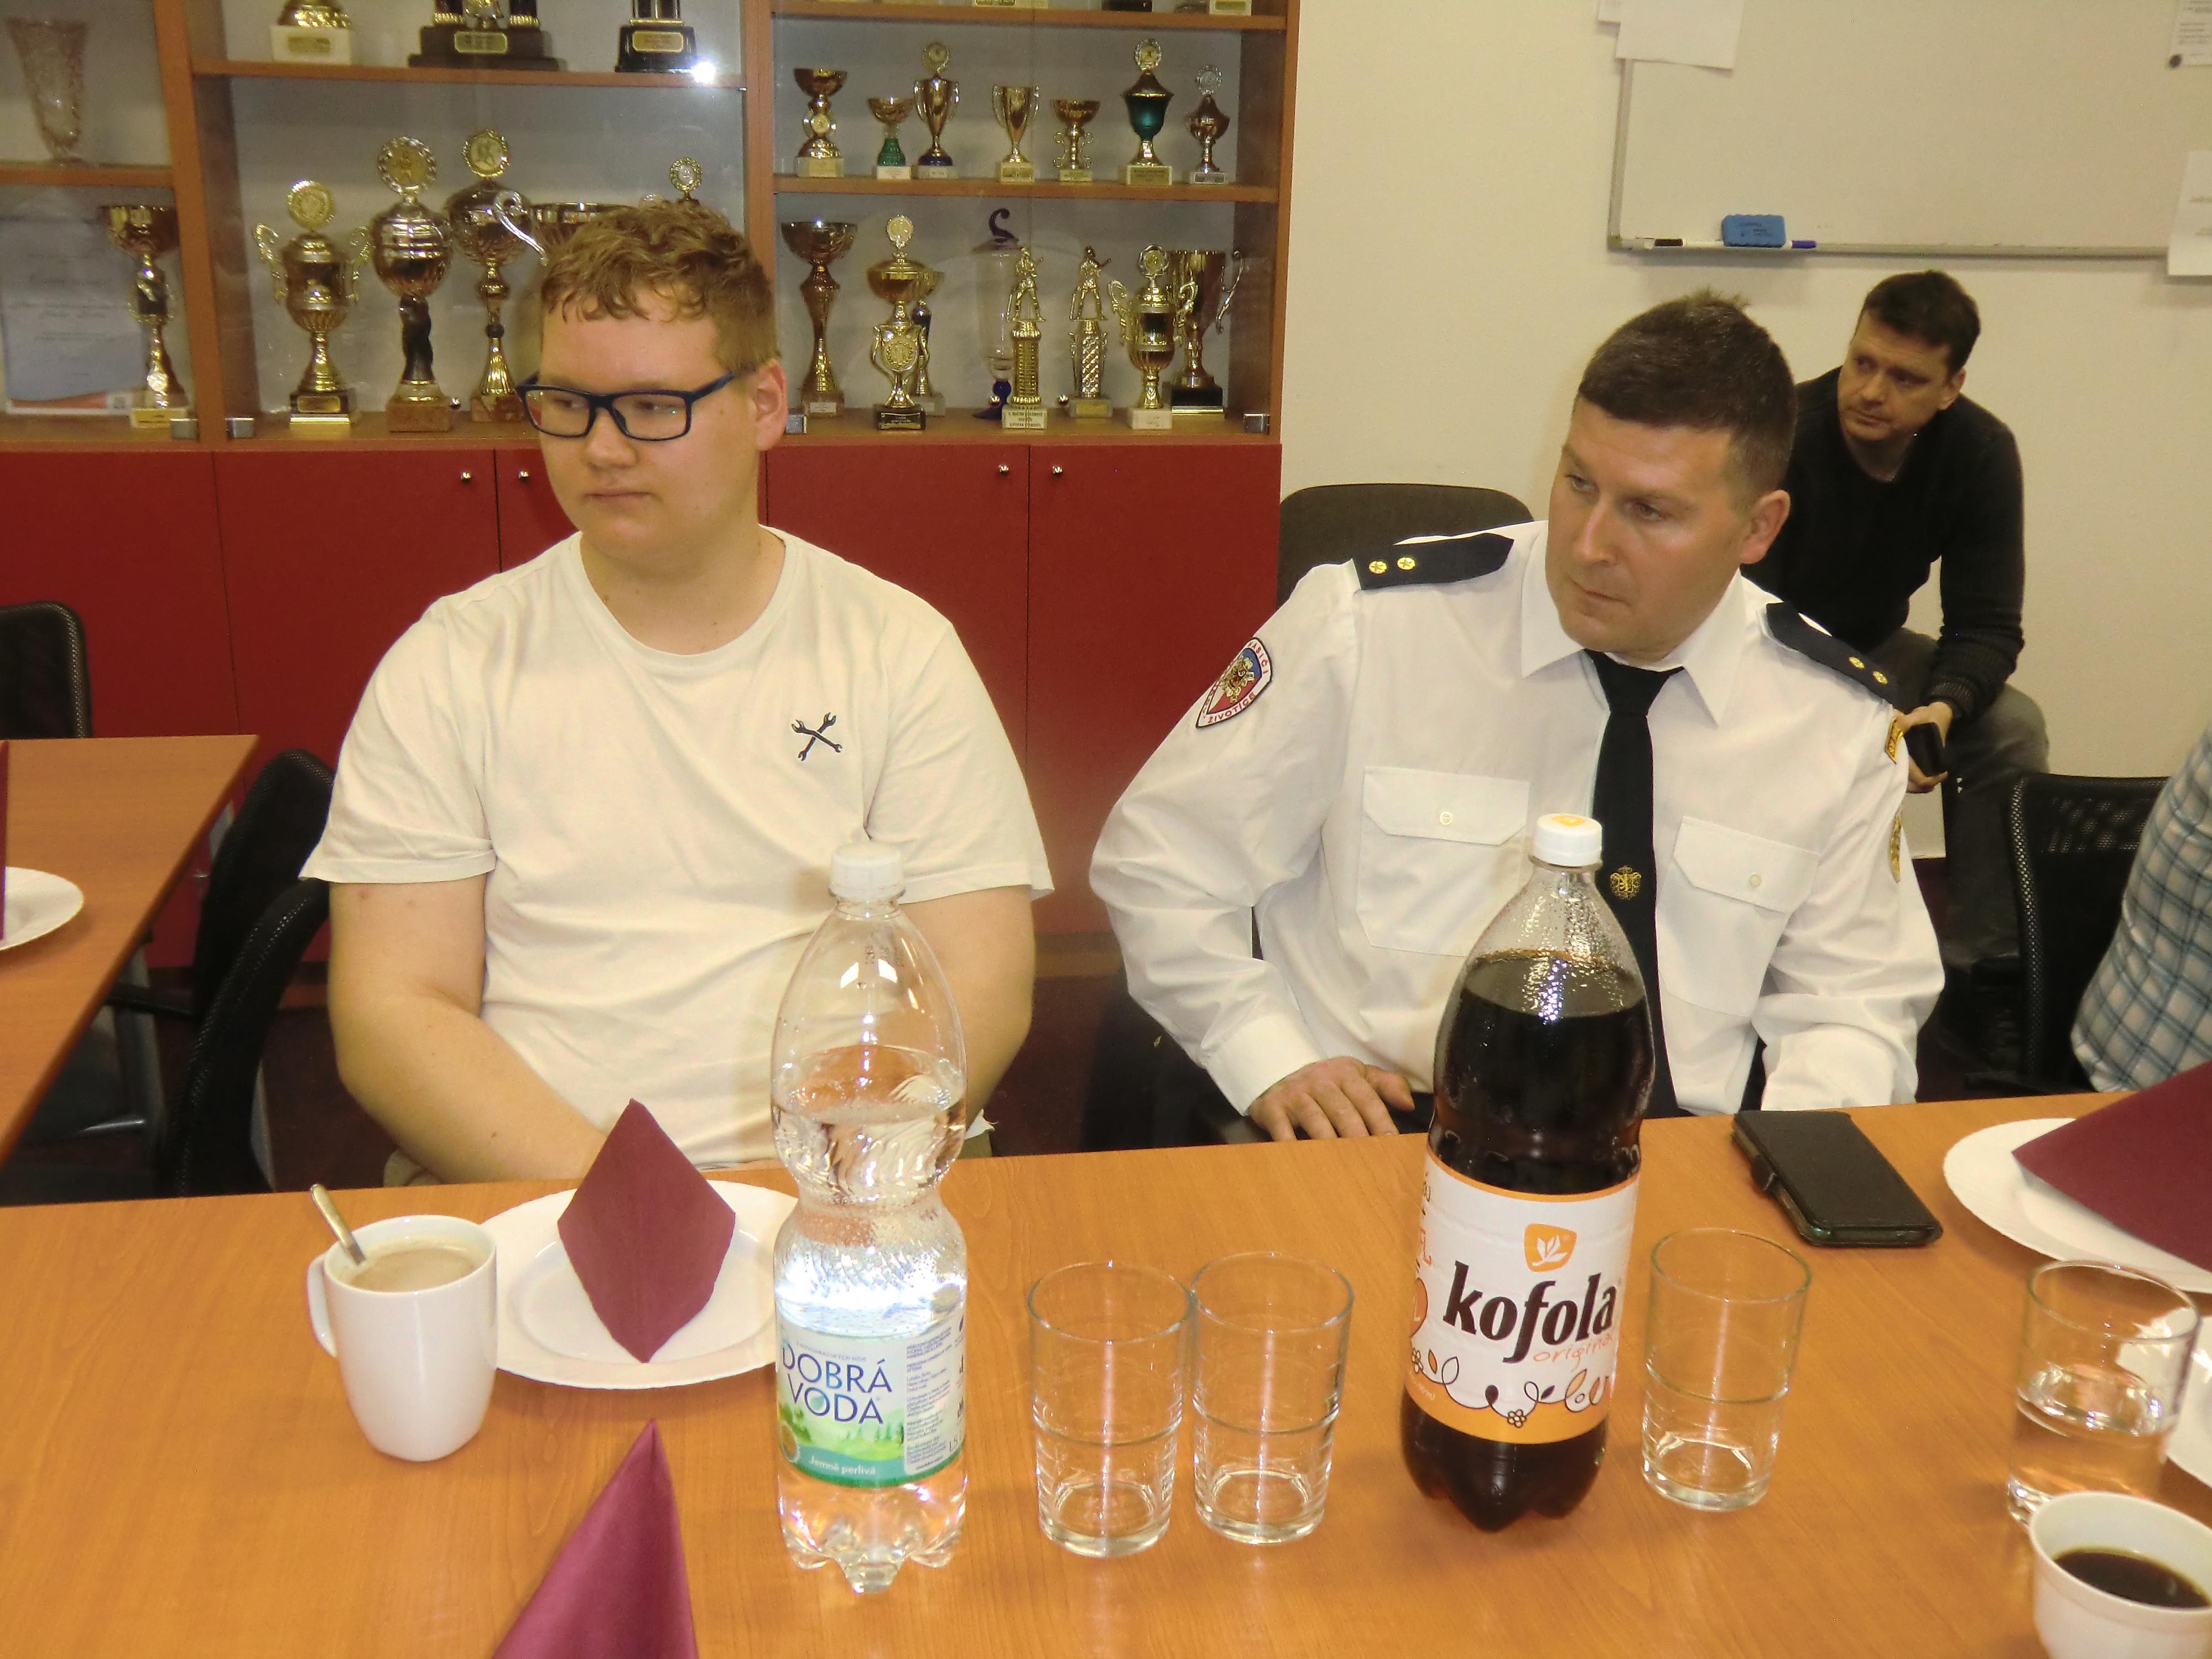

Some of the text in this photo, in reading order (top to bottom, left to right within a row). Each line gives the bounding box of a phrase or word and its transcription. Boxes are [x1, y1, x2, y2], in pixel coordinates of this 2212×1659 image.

[1208, 692, 1256, 724] ŽIVOTICE
[1443, 1260, 1617, 1364] kofola
[782, 1339, 893, 1393] DOBRÁ
[788, 1374, 884, 1425] VODA
